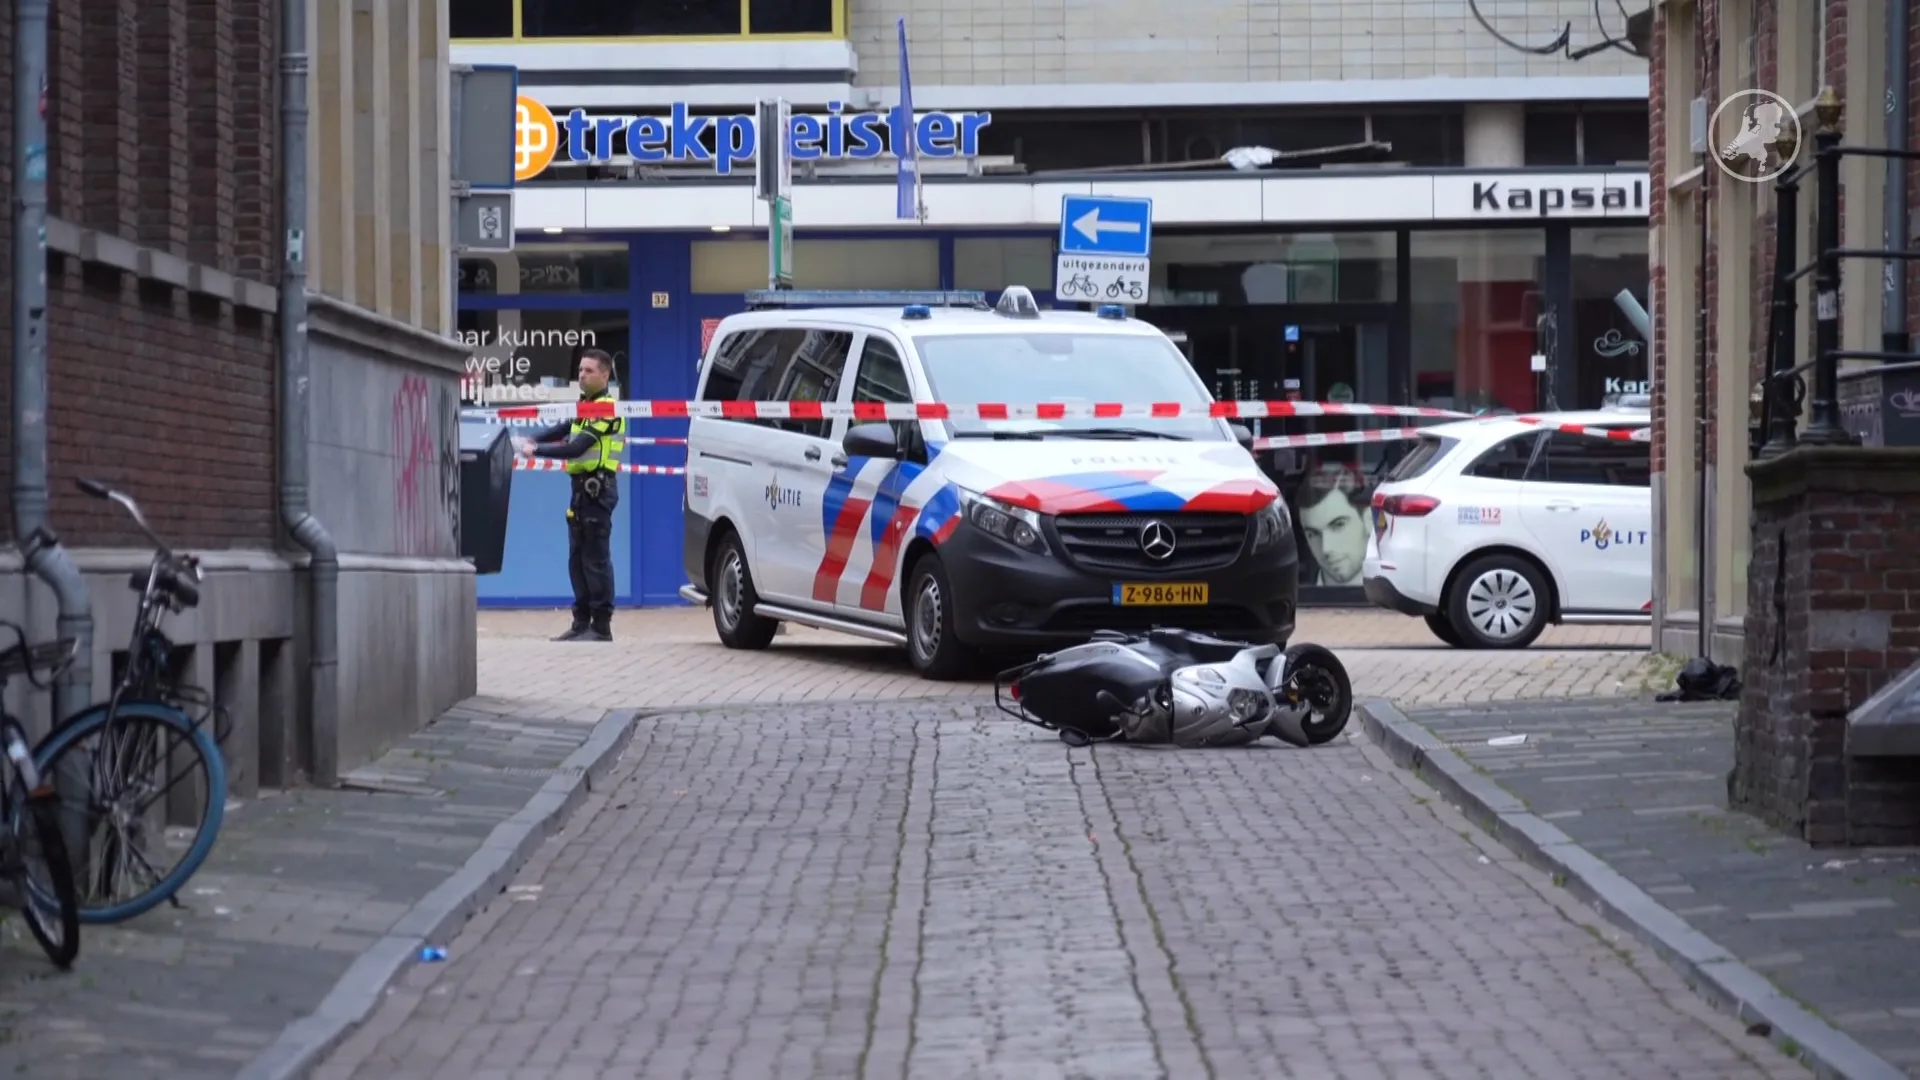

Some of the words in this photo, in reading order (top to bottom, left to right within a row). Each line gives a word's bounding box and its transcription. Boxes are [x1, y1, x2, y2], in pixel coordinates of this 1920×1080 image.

[564, 100, 991, 174] trekpeister
[1473, 181, 1642, 216] Kapsal
[1063, 259, 1145, 272] uitgezonderd
[498, 324, 596, 347] kunnen
[465, 356, 501, 373] we
[506, 352, 531, 378] je
[491, 383, 549, 400] mee
[1071, 455, 1182, 466] POLITIE
[765, 484, 802, 510] POLITIE
[1481, 507, 1501, 519] 112
[1126, 586, 1203, 602] Z-986-HN
